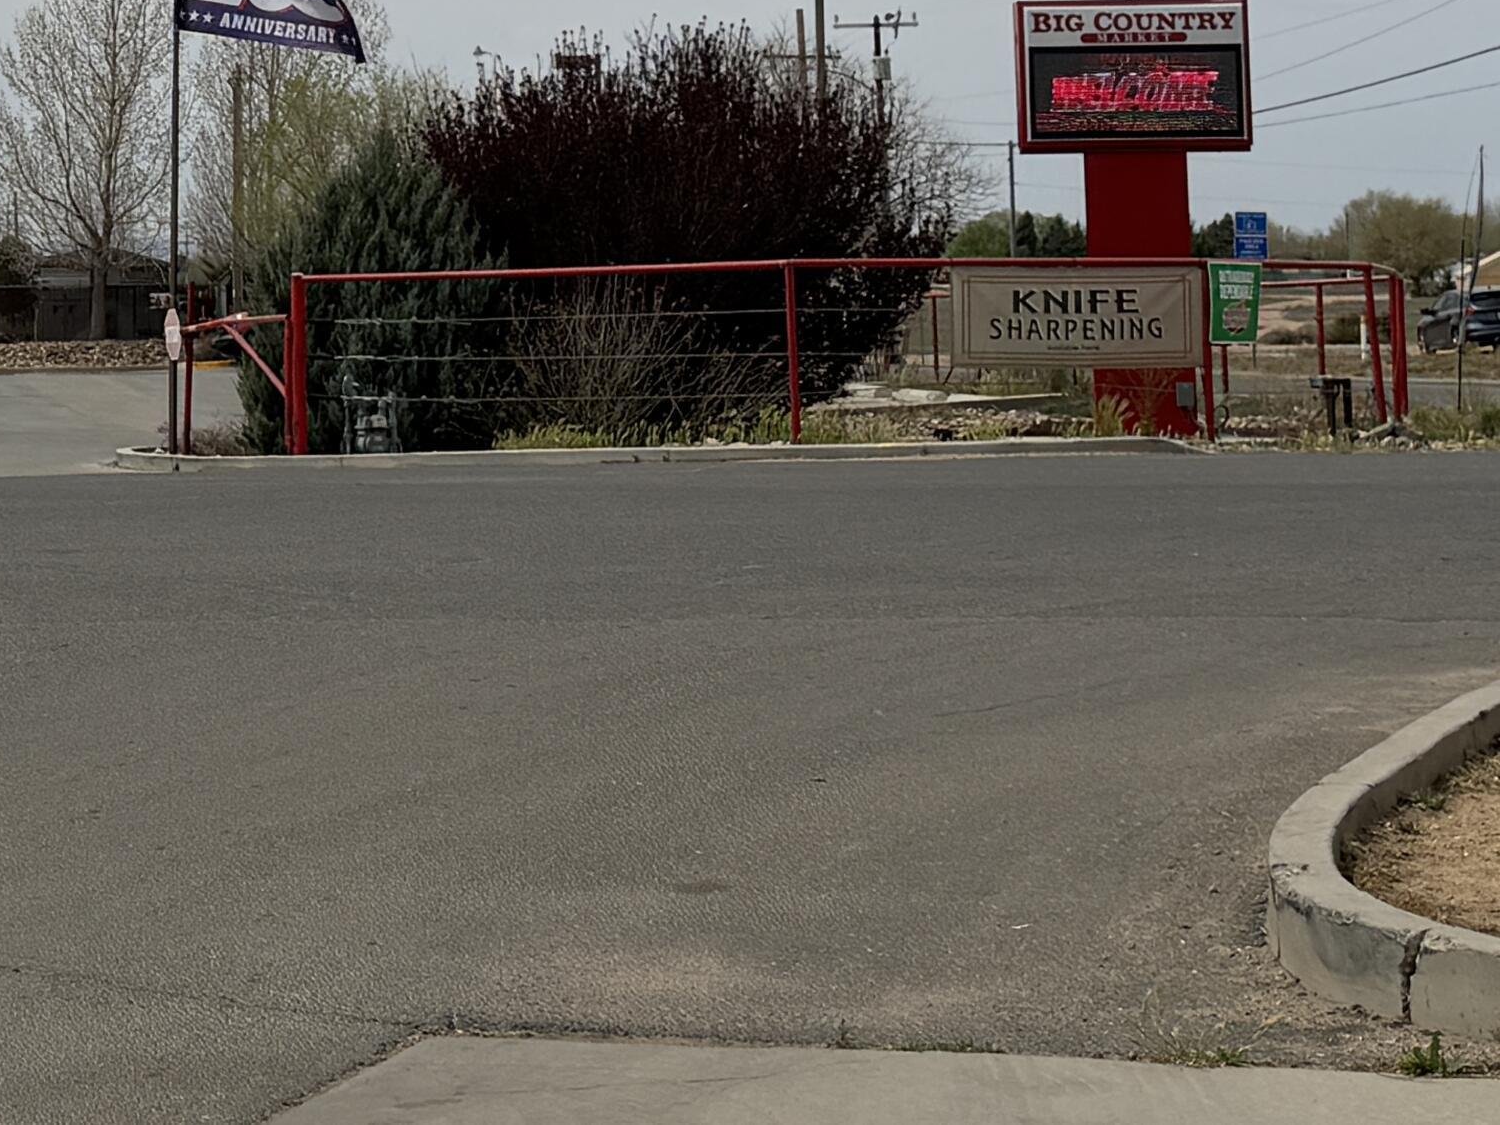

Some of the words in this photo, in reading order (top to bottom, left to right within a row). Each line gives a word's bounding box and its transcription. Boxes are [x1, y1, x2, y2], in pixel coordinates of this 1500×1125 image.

[219, 11, 336, 44] ANNIVERSARY
[1030, 12, 1085, 33] BIG
[1093, 11, 1237, 32] COUNTRY
[1095, 33, 1173, 43] MARKET
[1012, 288, 1140, 315] KNIFE
[988, 317, 1164, 341] SHARPENING
